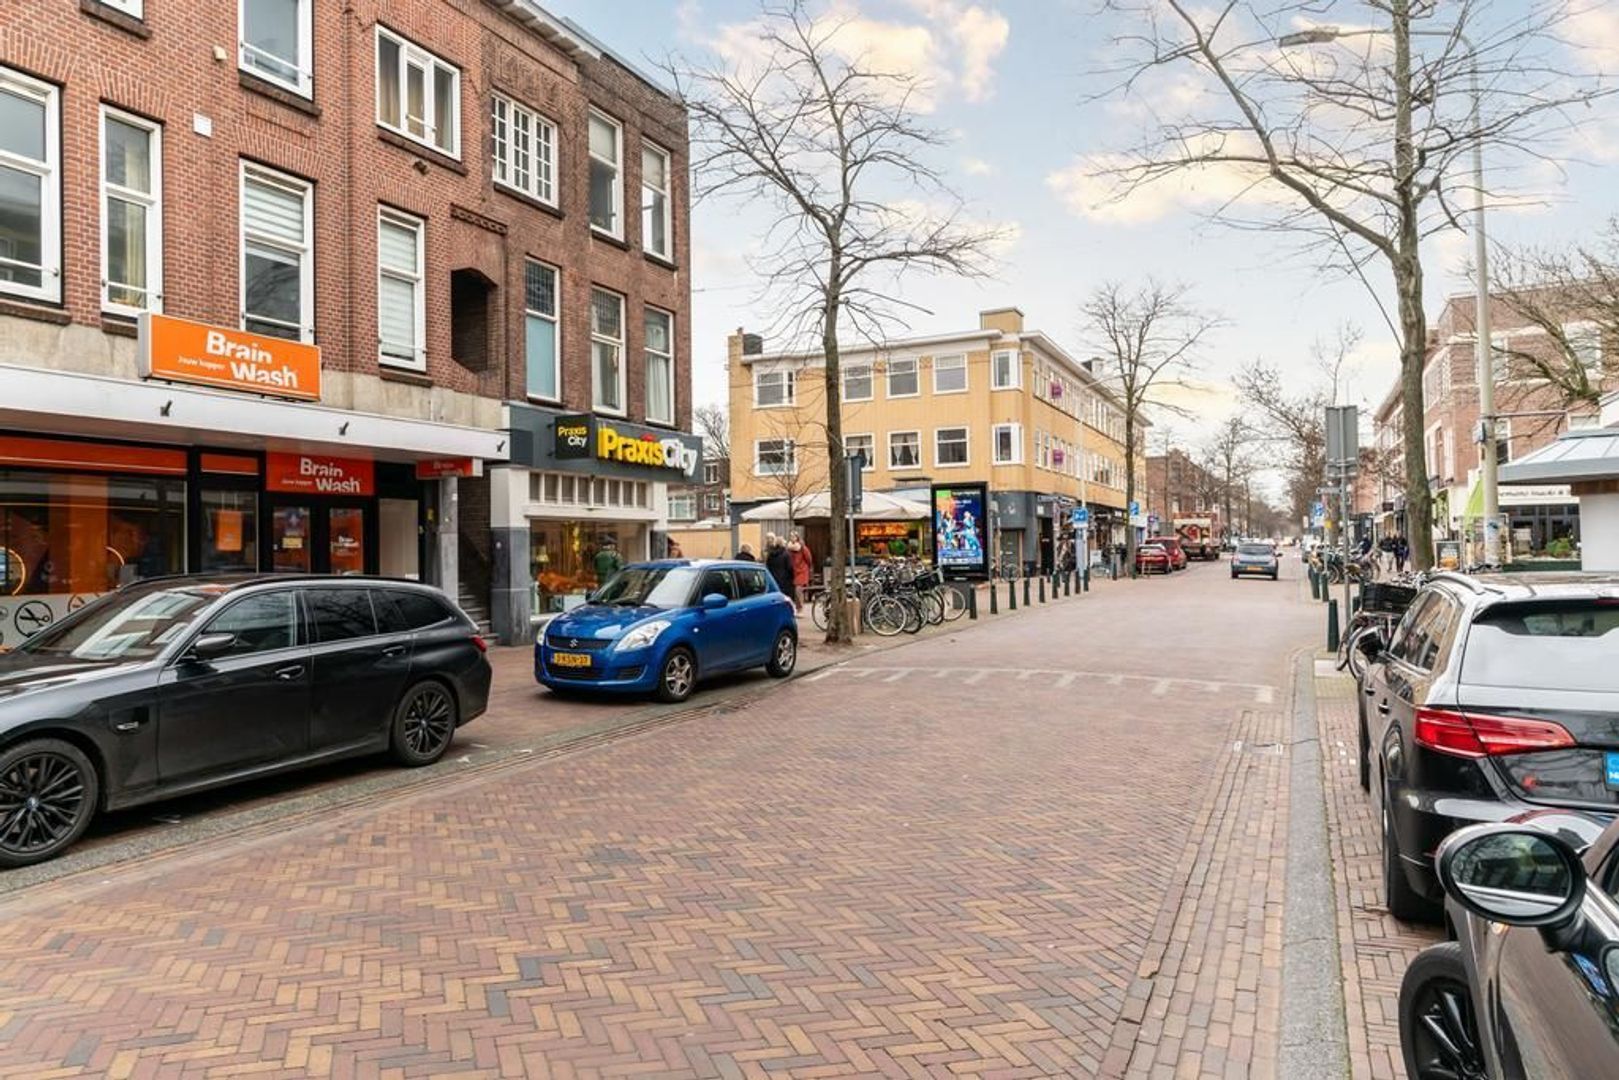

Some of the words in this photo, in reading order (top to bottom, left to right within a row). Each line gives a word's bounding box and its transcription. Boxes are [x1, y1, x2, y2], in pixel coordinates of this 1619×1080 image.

[206, 331, 272, 364] Brain
[230, 361, 298, 389] Wash
[558, 426, 587, 437] Praxis
[567, 436, 587, 448] City
[300, 457, 343, 477] Brain
[315, 477, 360, 493] Wash
